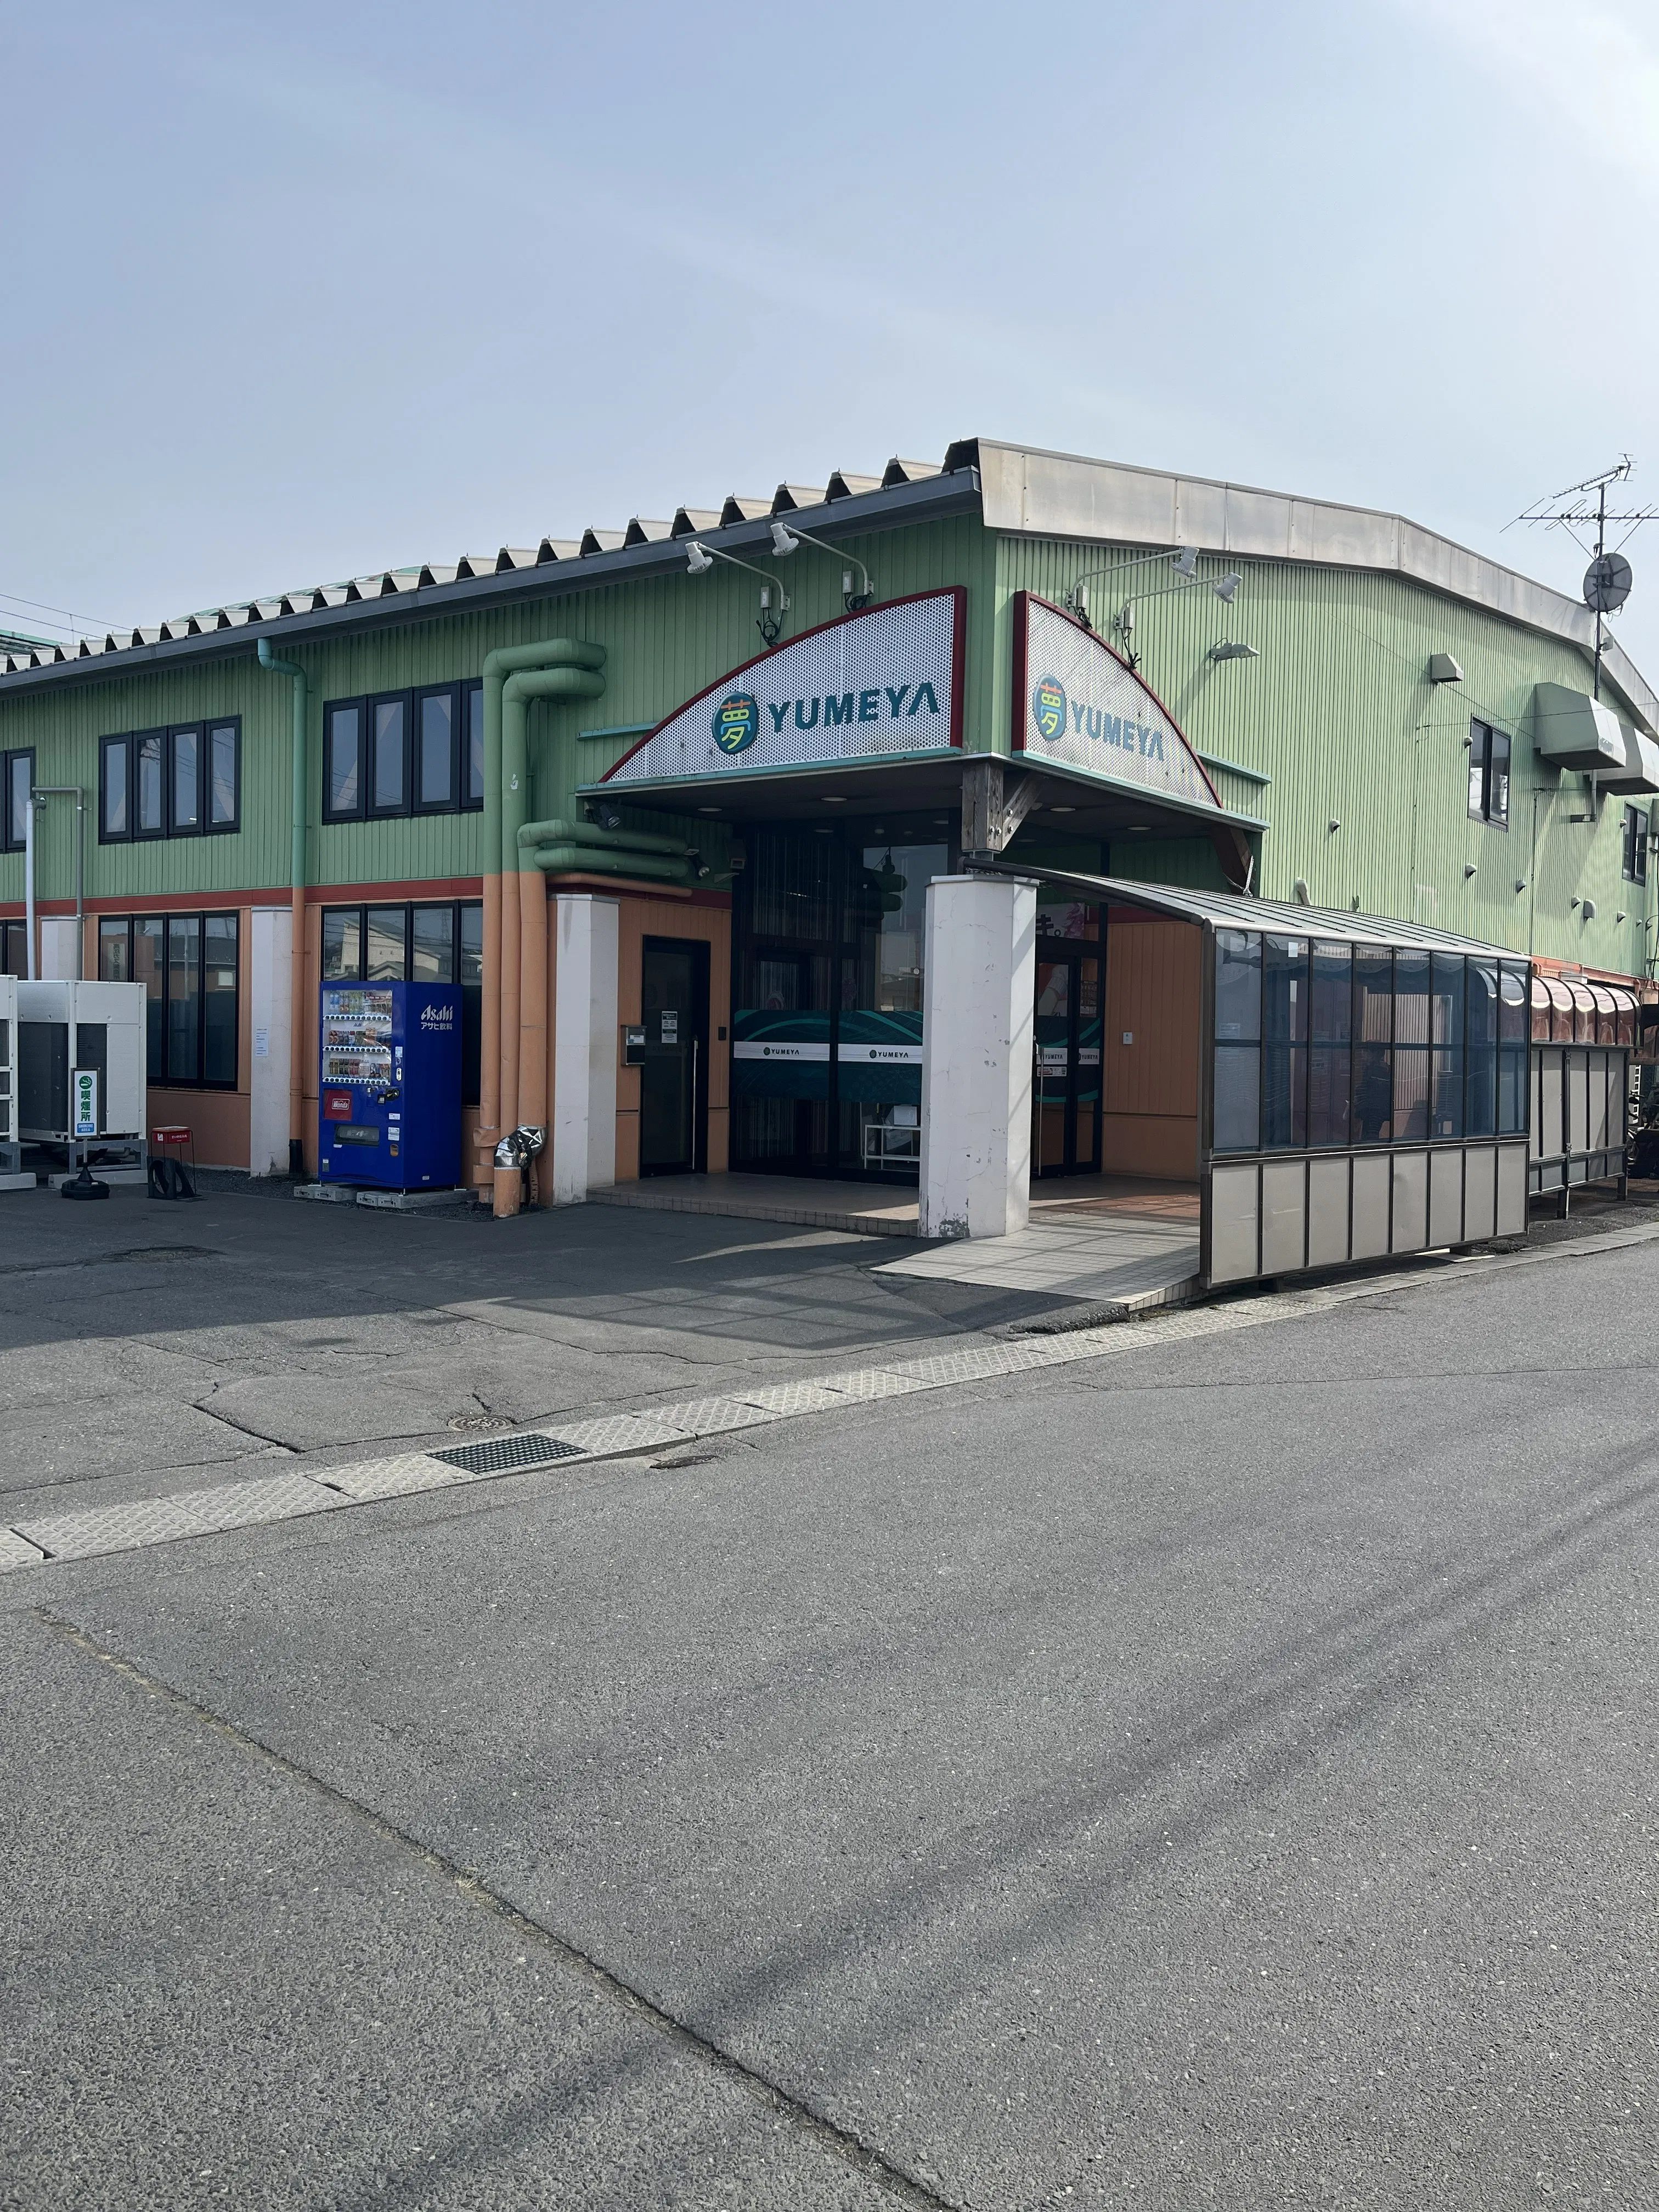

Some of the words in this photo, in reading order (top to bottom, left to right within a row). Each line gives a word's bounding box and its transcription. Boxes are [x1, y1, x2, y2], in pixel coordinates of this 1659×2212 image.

[720, 699, 751, 749] 夢
[769, 682, 940, 733] YUMEYA
[1040, 682, 1063, 735] 夢
[1071, 701, 1164, 761] YUMEYA
[421, 1005, 453, 1021] Asahi
[421, 1022, 453, 1030] アサヒ飲料
[81, 1090, 91, 1121] 喫煙所
